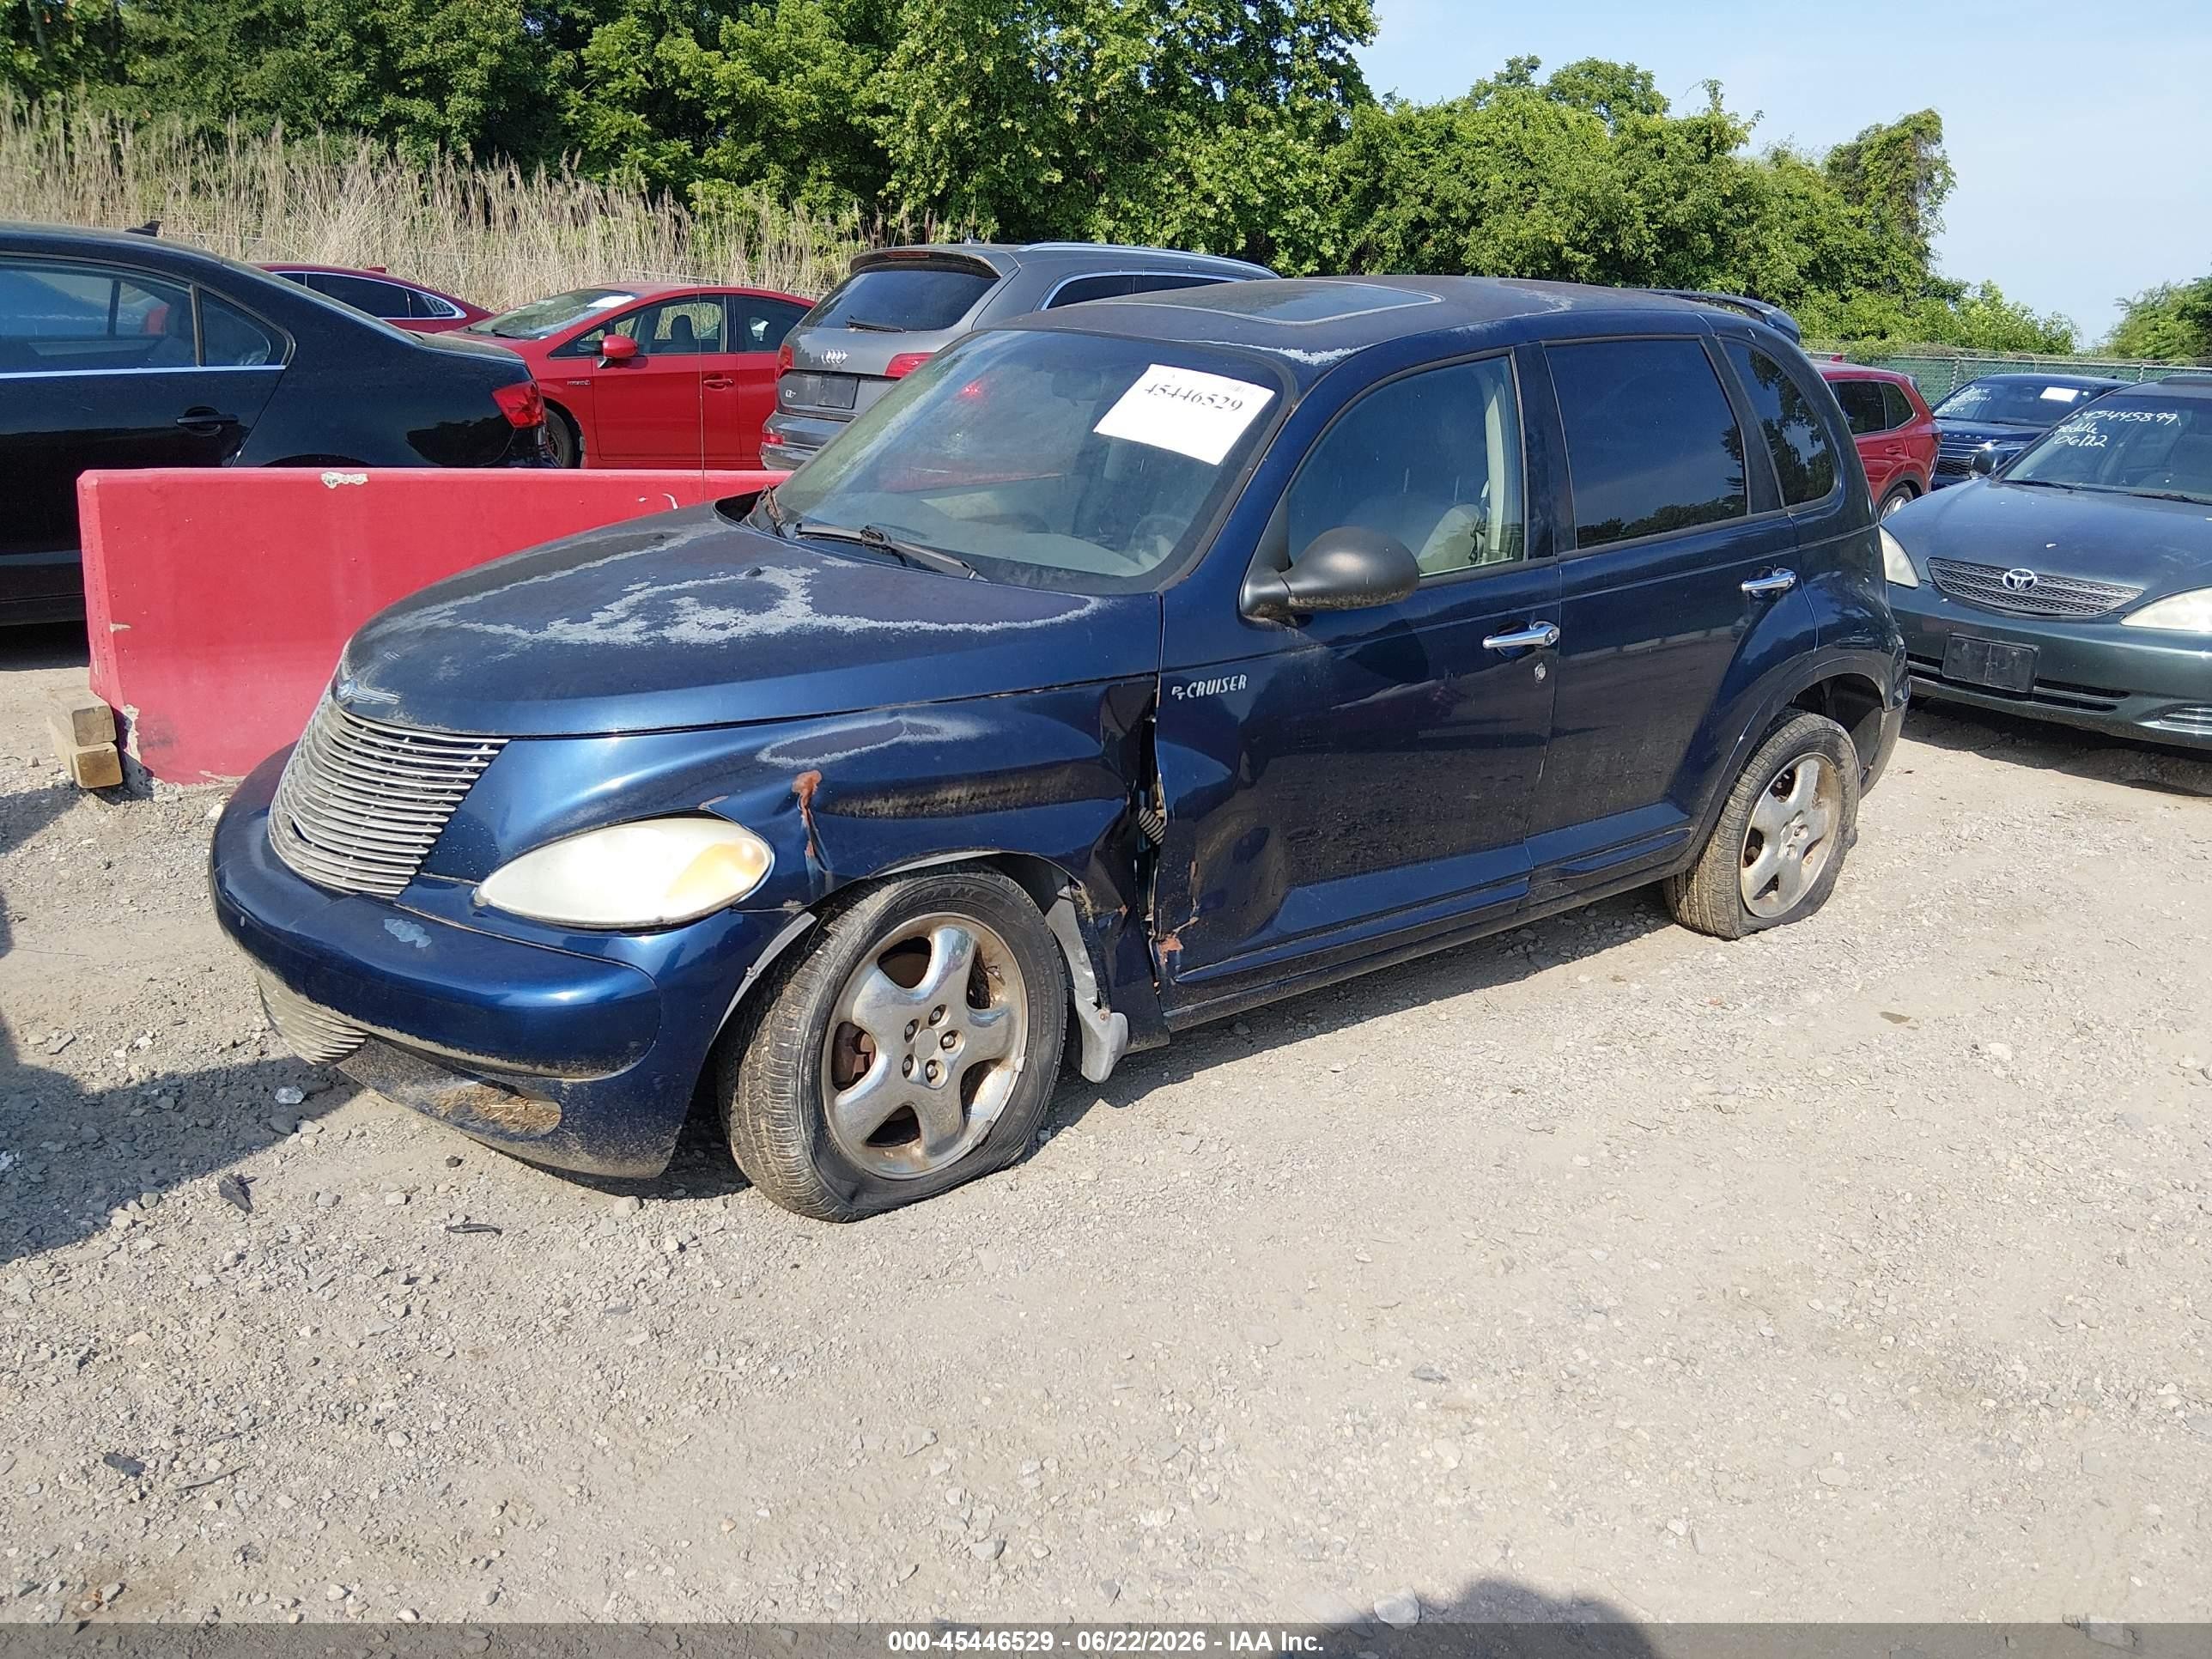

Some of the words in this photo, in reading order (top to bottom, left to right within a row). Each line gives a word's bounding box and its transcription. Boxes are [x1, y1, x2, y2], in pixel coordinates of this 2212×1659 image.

[1144, 383, 1243, 411] 45446529
[1171, 686, 1186, 701] PT
[1187, 674, 1247, 698] CRUISER
